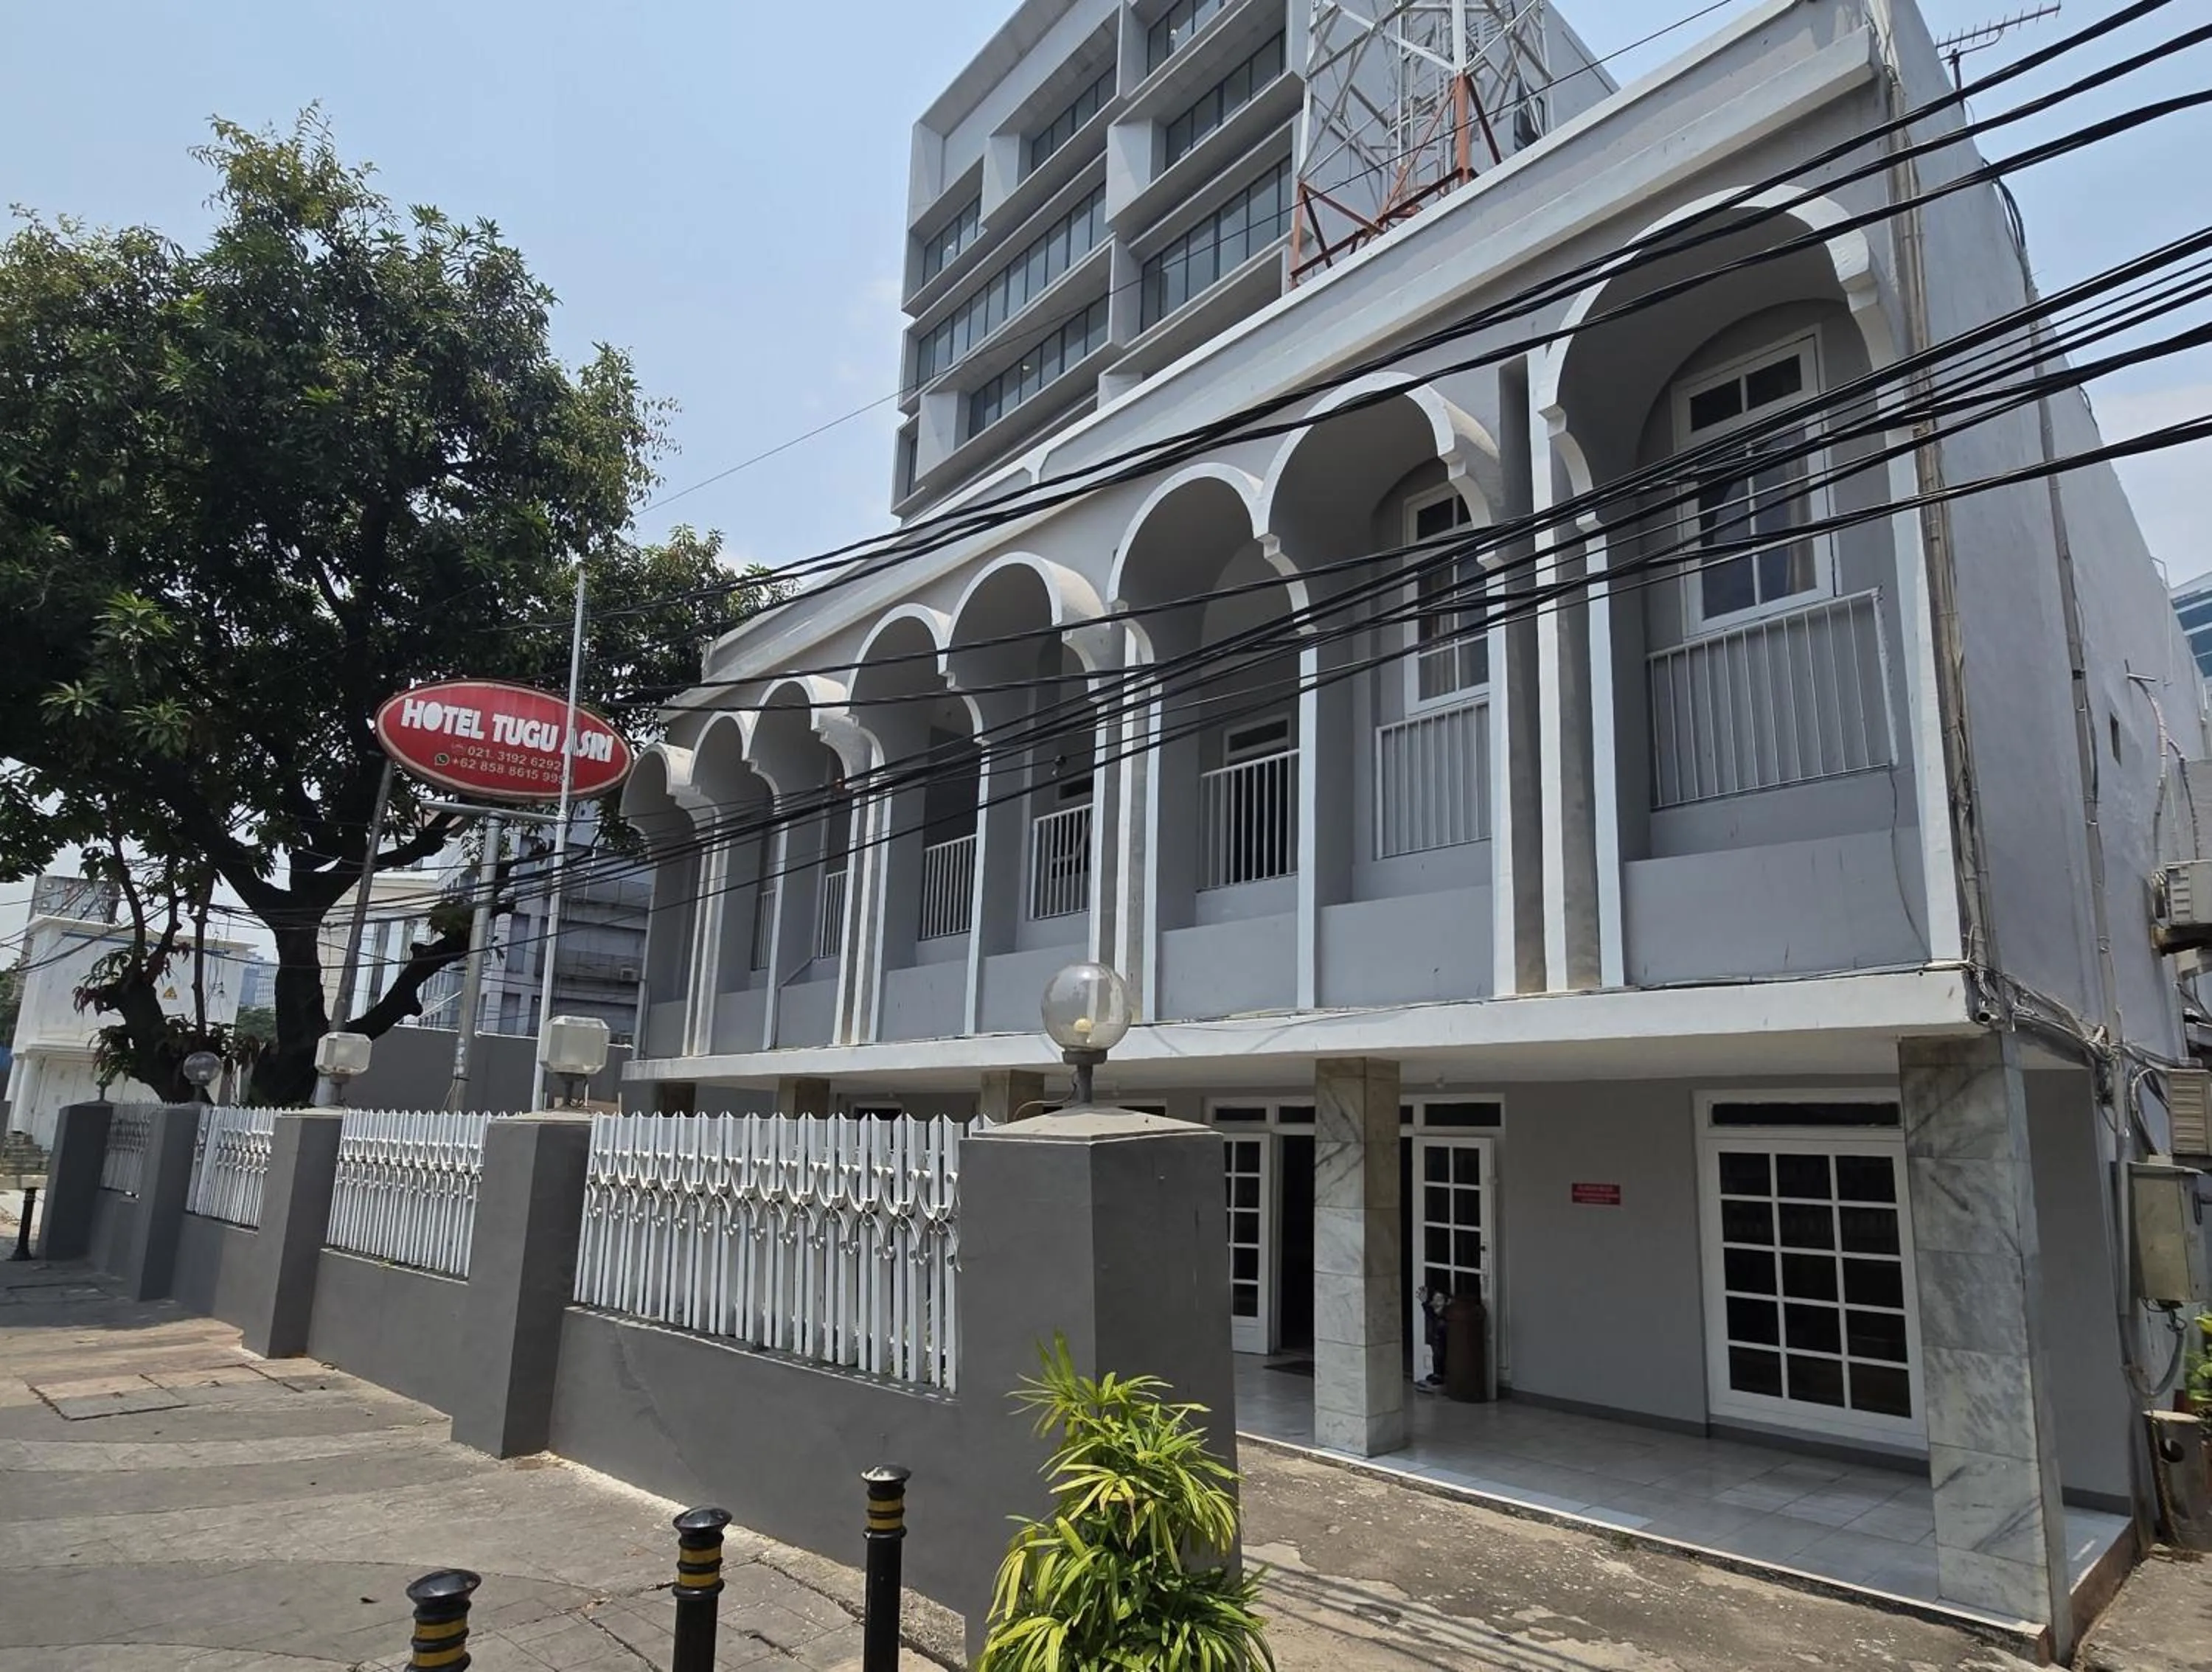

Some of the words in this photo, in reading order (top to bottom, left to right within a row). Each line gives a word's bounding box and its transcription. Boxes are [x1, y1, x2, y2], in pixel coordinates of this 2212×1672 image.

[400, 699, 484, 740] HOTEL
[493, 714, 559, 753] TUGU
[453, 757, 477, 770] +62
[480, 761, 505, 774] 858
[508, 765, 538, 780] 8615
[498, 750, 527, 765] 3192
[530, 756, 562, 771] 6292
